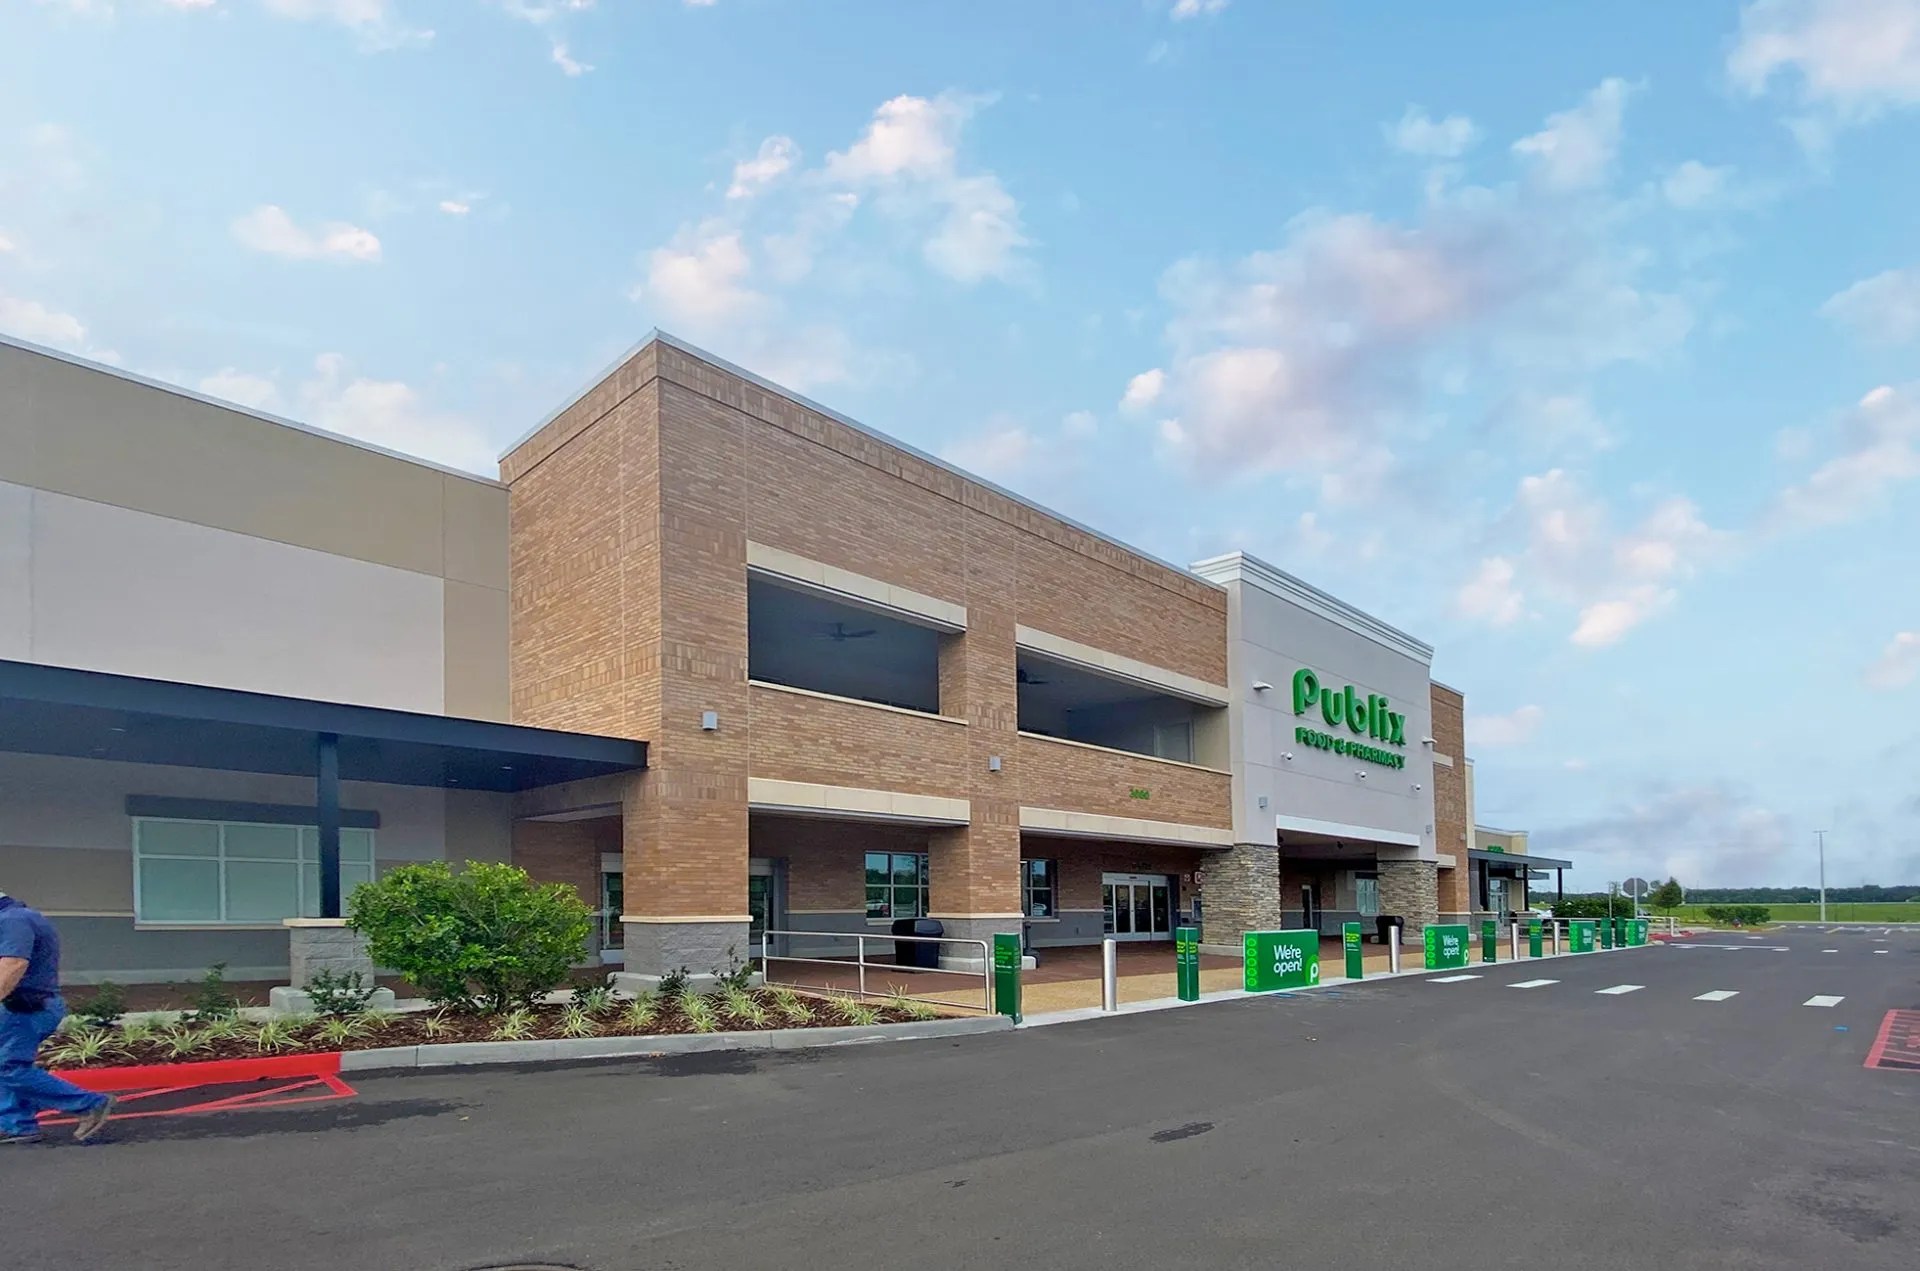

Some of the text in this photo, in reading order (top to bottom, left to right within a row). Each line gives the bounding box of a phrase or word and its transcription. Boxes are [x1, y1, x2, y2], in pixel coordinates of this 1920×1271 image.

[1293, 668, 1406, 747] Publix
[1295, 727, 1405, 769] FOOD & PHARMACY
[1273, 944, 1302, 960] We're
[1273, 958, 1302, 977] open!
